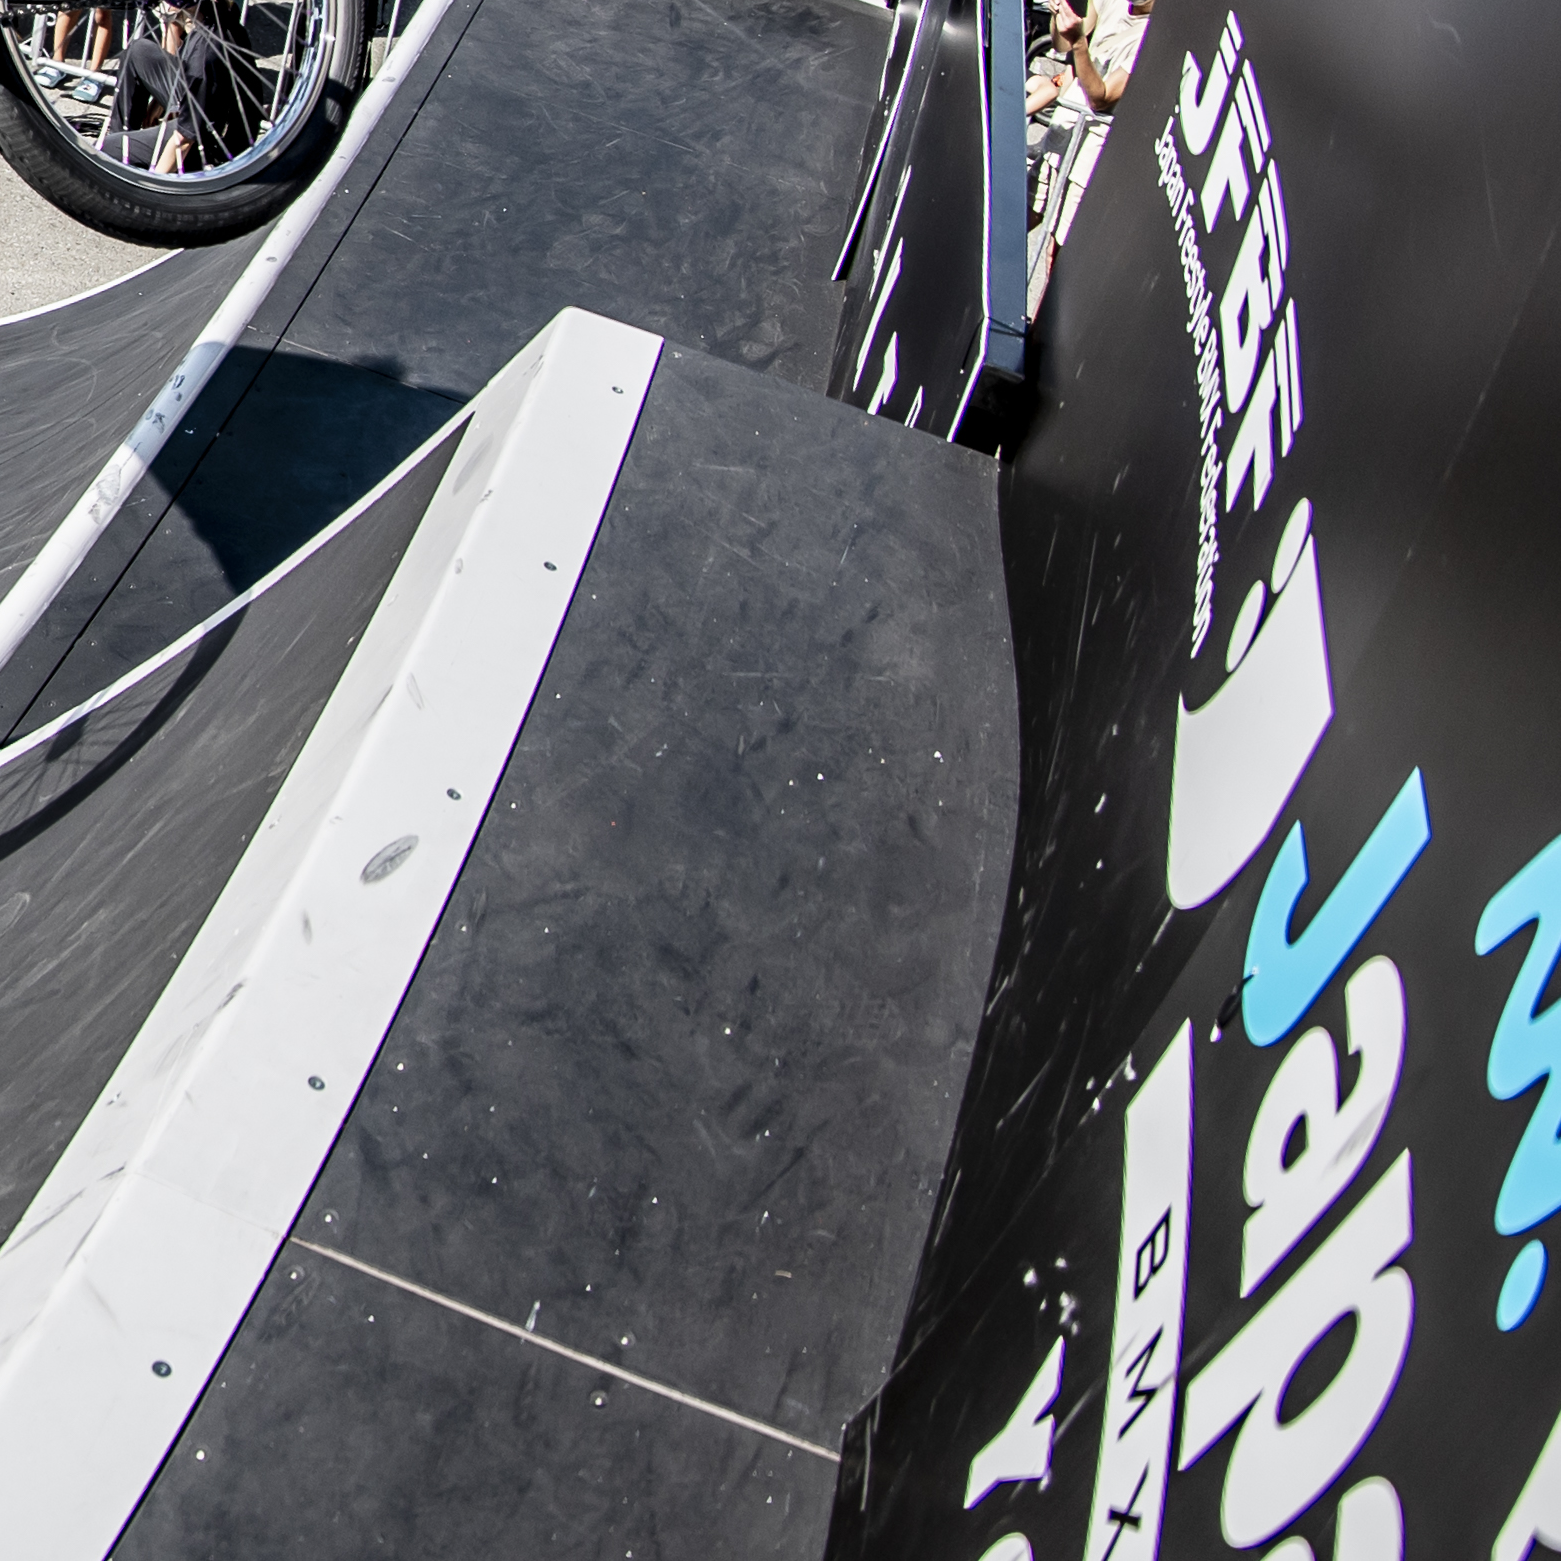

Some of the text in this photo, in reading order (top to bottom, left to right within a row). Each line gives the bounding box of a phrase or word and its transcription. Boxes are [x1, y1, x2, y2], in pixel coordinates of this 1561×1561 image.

[1155, 115, 1224, 659] Japan Freestyle BMX Federation
[1180, 9, 1304, 513] JFBF
[1103, 1203, 1171, 1561] BMX
[1178, 766, 1433, 1561] Jap
